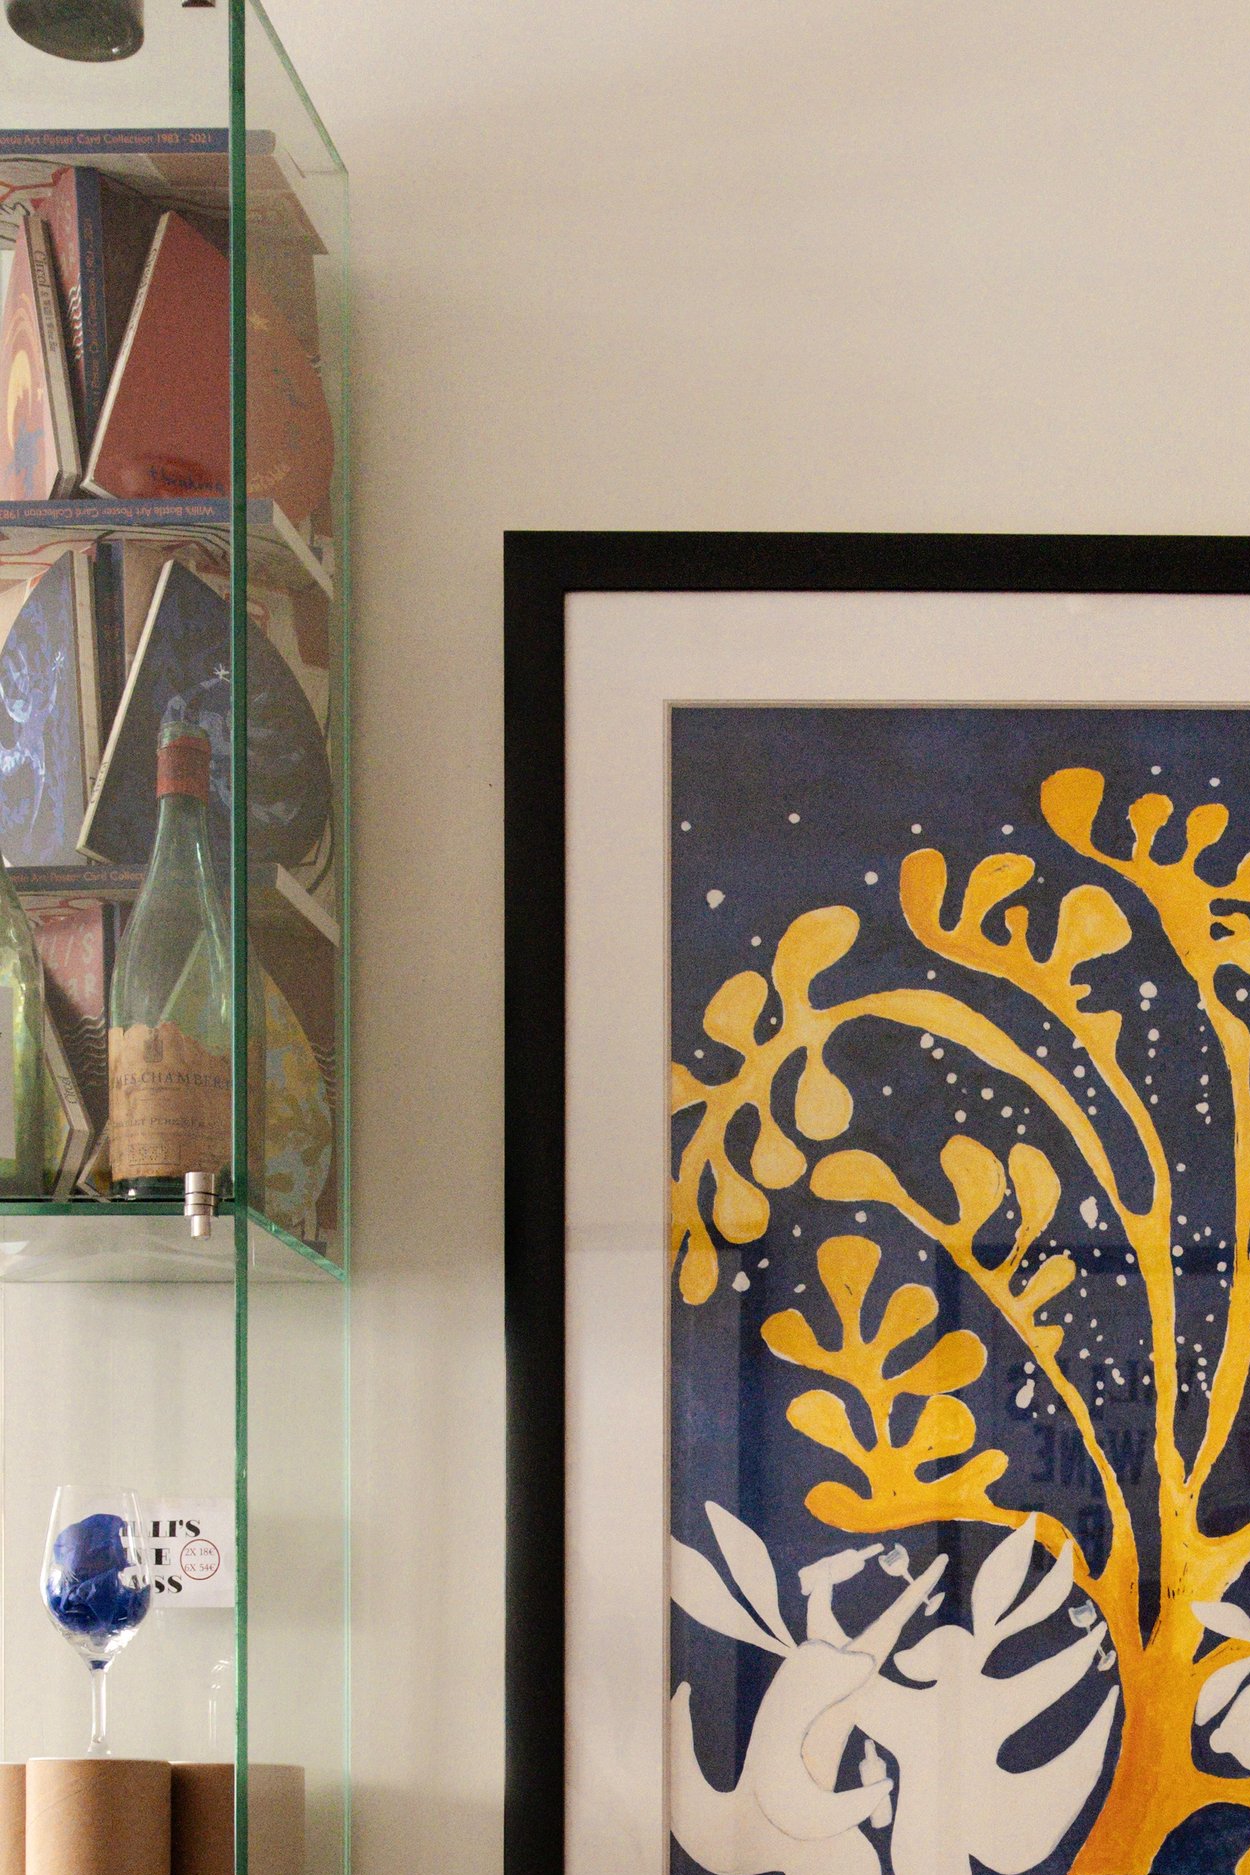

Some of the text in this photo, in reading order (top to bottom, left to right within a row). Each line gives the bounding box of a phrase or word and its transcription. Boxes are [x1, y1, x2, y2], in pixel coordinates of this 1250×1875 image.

[0, 134, 21, 145] ottle
[77, 133, 100, 145] Card
[104, 133, 152, 145] Collection
[184, 1547, 215, 1557] 2X 18€
[184, 1564, 197, 1572] 6X
